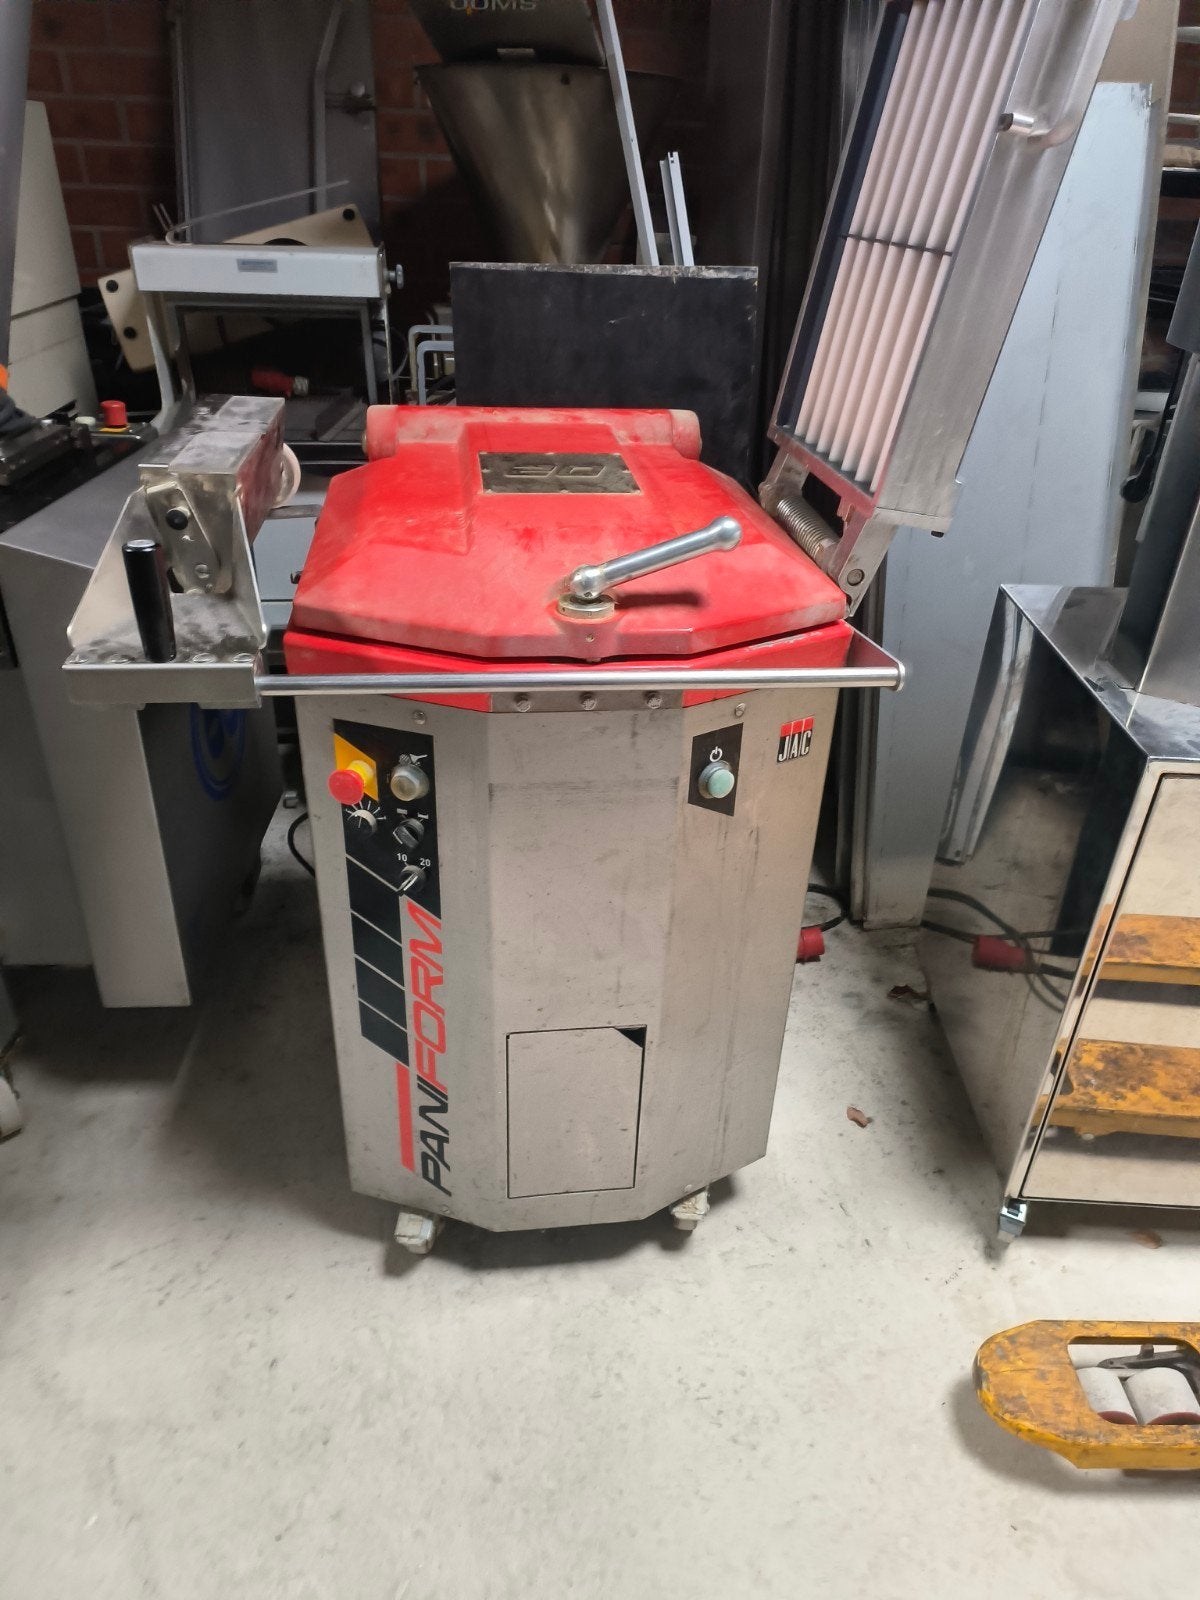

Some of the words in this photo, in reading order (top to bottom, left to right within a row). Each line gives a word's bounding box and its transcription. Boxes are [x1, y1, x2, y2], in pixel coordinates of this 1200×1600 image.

[778, 730, 812, 762] JAC
[397, 853, 408, 862] 10
[420, 858, 431, 867] 20
[407, 900, 452, 1197] PANIFORM
